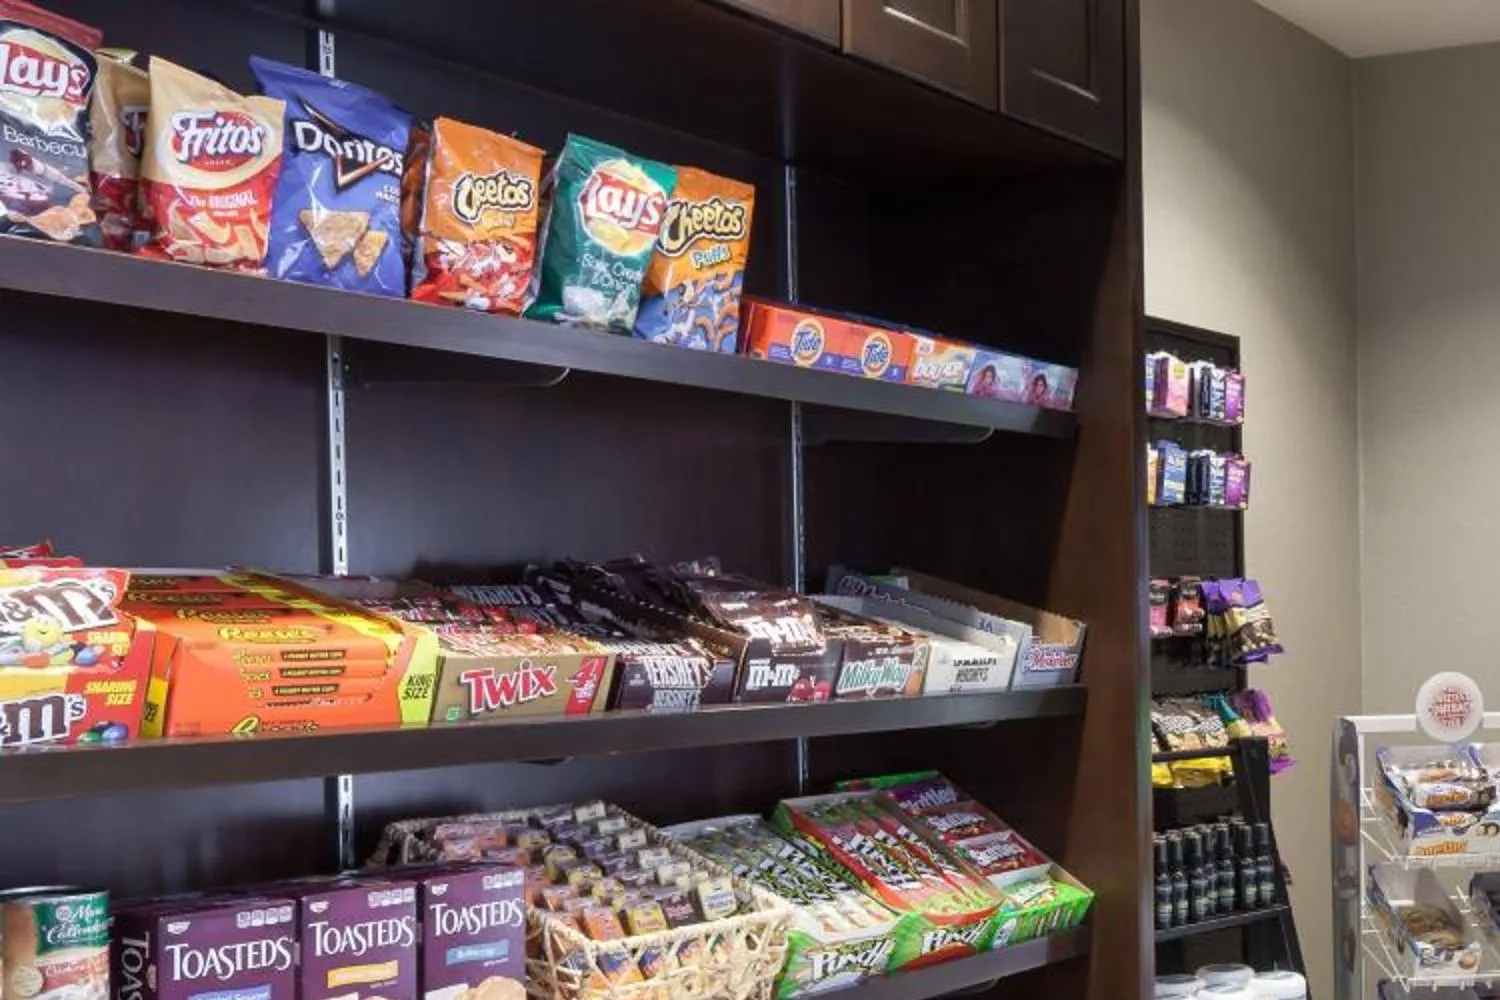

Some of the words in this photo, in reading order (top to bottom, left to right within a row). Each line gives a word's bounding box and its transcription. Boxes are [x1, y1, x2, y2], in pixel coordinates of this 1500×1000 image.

[171, 110, 263, 162] Fritos
[293, 121, 403, 176] Doritos
[455, 170, 532, 222] Ceetos
[657, 197, 747, 256] Cheetos
[403, 687, 429, 700] SIZE
[461, 659, 556, 713] Twix
[307, 916, 415, 957] TOASTEDS
[429, 898, 526, 937] TOASTEDS
[165, 937, 292, 981] TOASTEDS
